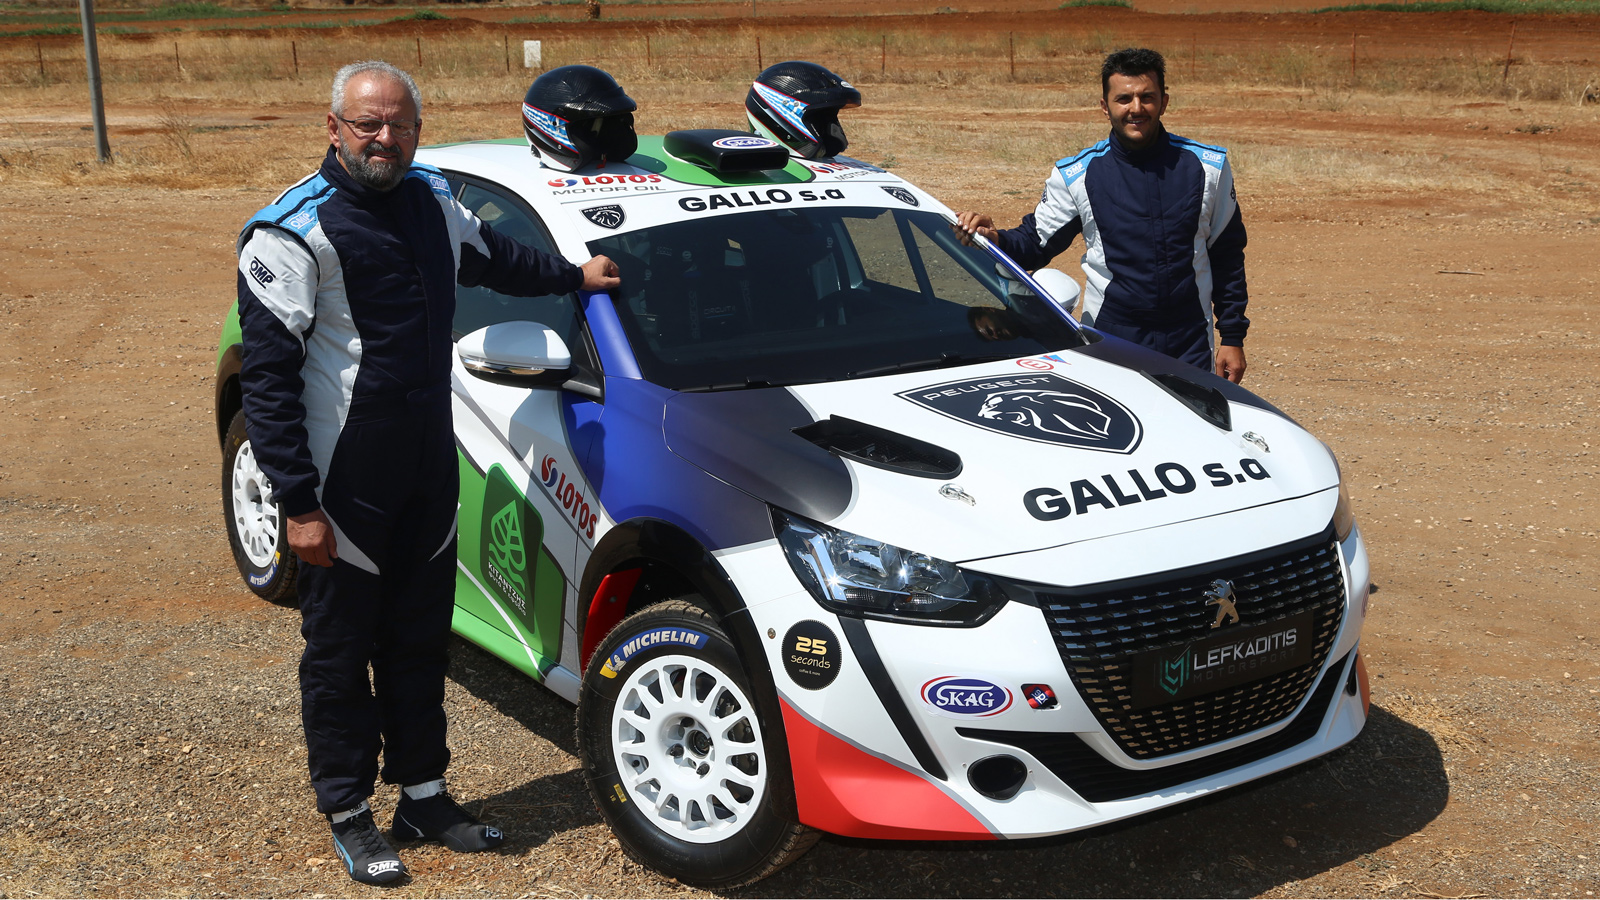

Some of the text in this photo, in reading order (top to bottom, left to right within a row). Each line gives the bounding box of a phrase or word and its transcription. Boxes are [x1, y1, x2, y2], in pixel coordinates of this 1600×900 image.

[1202, 152, 1222, 161] OMP
[581, 174, 662, 186] LOTOS
[1065, 163, 1084, 176] OMP
[552, 186, 628, 196] MOTOR
[677, 188, 846, 212] GALLO s.a
[289, 212, 311, 228] OMP
[583, 205, 618, 213] PEUGEOT
[249, 259, 275, 284] OMP
[922, 376, 1051, 402] PEUGEOT
[1022, 458, 1272, 522] GALLO s.a
[555, 472, 598, 540] LOTOS
[622, 630, 701, 659] MICHELIN
[795, 635, 828, 656] 25
[1193, 628, 1298, 671] LEFKADITIS
[790, 654, 831, 669] seconds
[1193, 648, 1297, 684] MOTORSPORT
[935, 684, 996, 708] SKAG
